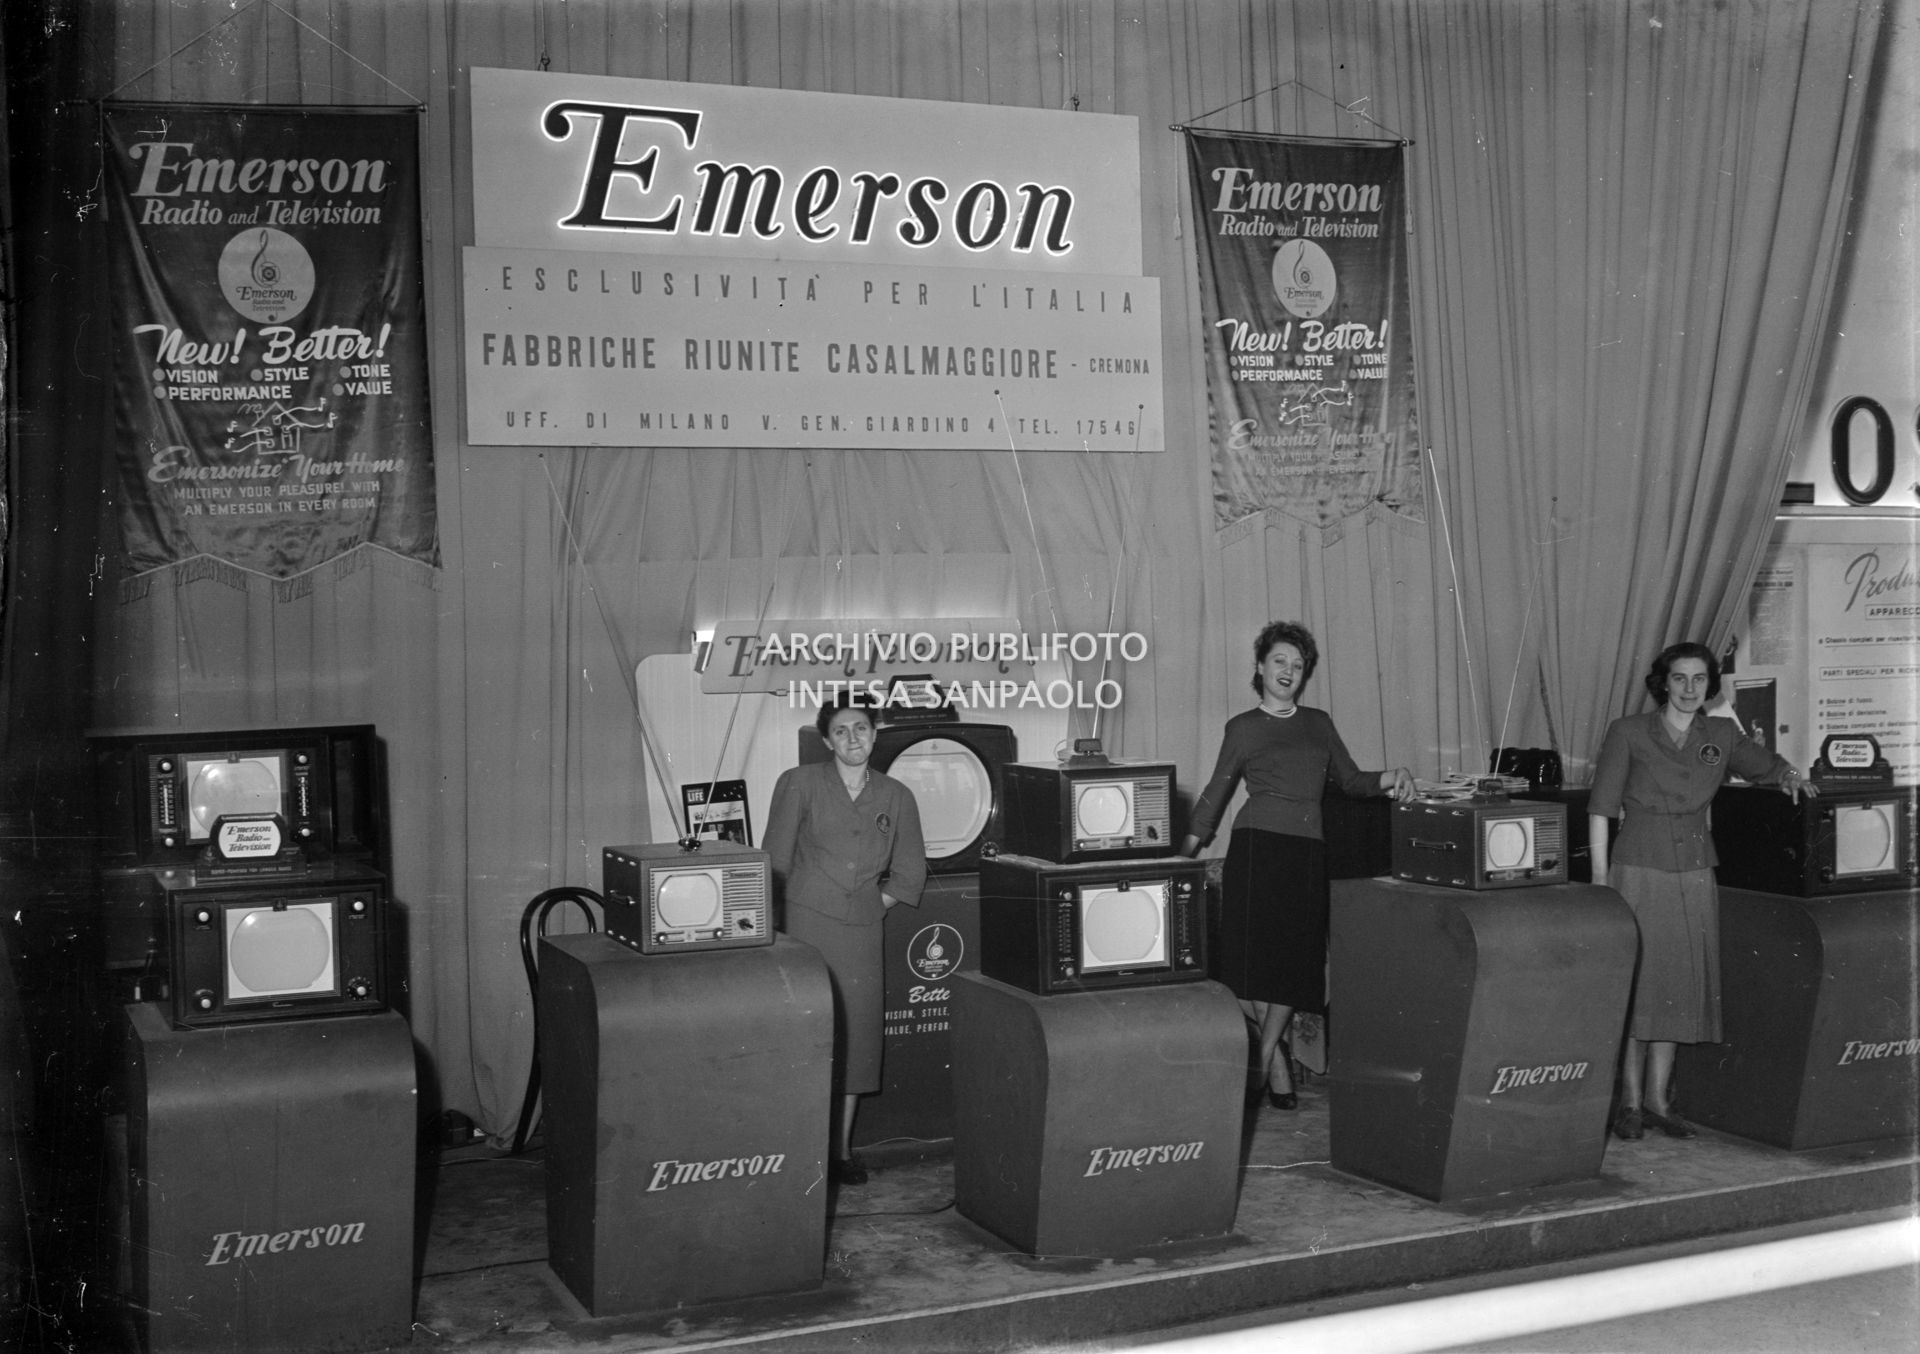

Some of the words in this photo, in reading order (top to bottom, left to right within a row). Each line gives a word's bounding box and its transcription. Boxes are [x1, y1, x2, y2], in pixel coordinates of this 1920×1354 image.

[129, 142, 387, 196] Emerson
[540, 99, 1074, 255] Emerson
[1212, 167, 1382, 213] Emerson
[140, 199, 222, 225] Radio
[228, 206, 259, 224] and
[266, 200, 381, 225] Television
[1219, 214, 1275, 236] Radio
[1278, 221, 1298, 237] and
[1302, 216, 1379, 238] Television
[236, 286, 297, 301] Emerson
[502, 266, 821, 301] ESCLUSIVITÀ
[864, 281, 928, 305] PER
[973, 283, 1132, 314] L'ITALIA
[133, 324, 246, 365] New!
[258, 323, 391, 364] Better!
[1216, 319, 1292, 351] New!
[1300, 319, 1388, 351] Better!
[483, 333, 656, 369] FABBRICHE
[685, 338, 799, 372] RIUNITE
[827, 343, 1057, 379] CASALMAGGIORE
[1090, 358, 1150, 375] CREMONA
[1238, 355, 1274, 367] VISION
[1304, 354, 1334, 366] STYLE
[1361, 353, 1388, 365] TONE
[166, 369, 218, 383] VISION
[264, 367, 310, 381] STYLE
[352, 364, 391, 378] TONE
[1240, 369, 1323, 381] PERFORMANCE
[1357, 367, 1388, 379] VALUE
[168, 385, 292, 400] PERFORMANCE
[345, 382, 393, 396] VALUE
[506, 411, 558, 428] UFF.
[587, 412, 607, 428] DI
[640, 413, 729, 430] MILANO
[762, 415, 777, 430] V.
[801, 415, 847, 432] GEN.
[866, 416, 969, 433] GIARDINO
[987, 417, 995, 433] 4
[1019, 418, 1058, 435] TEL.
[1077, 420, 1135, 436] 17546
[290, 454, 344, 483] Your
[174, 485, 232, 500] MULTIPLY
[239, 484, 272, 498] YOUR
[351, 480, 380, 493] WITH
[185, 502, 202, 516] AN
[209, 500, 272, 515] EMERSON
[279, 500, 292, 513] IN
[299, 498, 337, 512] EVERY
[342, 496, 376, 510] ROOM
[227, 826, 271, 835] Emerson
[235, 833, 262, 842] Radio
[228, 843, 272, 852] Television
[1490, 1060, 1589, 1095] Emerson
[1083, 1140, 1205, 1178] Emerson
[646, 1152, 786, 1193] Emerson
[205, 1221, 365, 1266] Emerson
